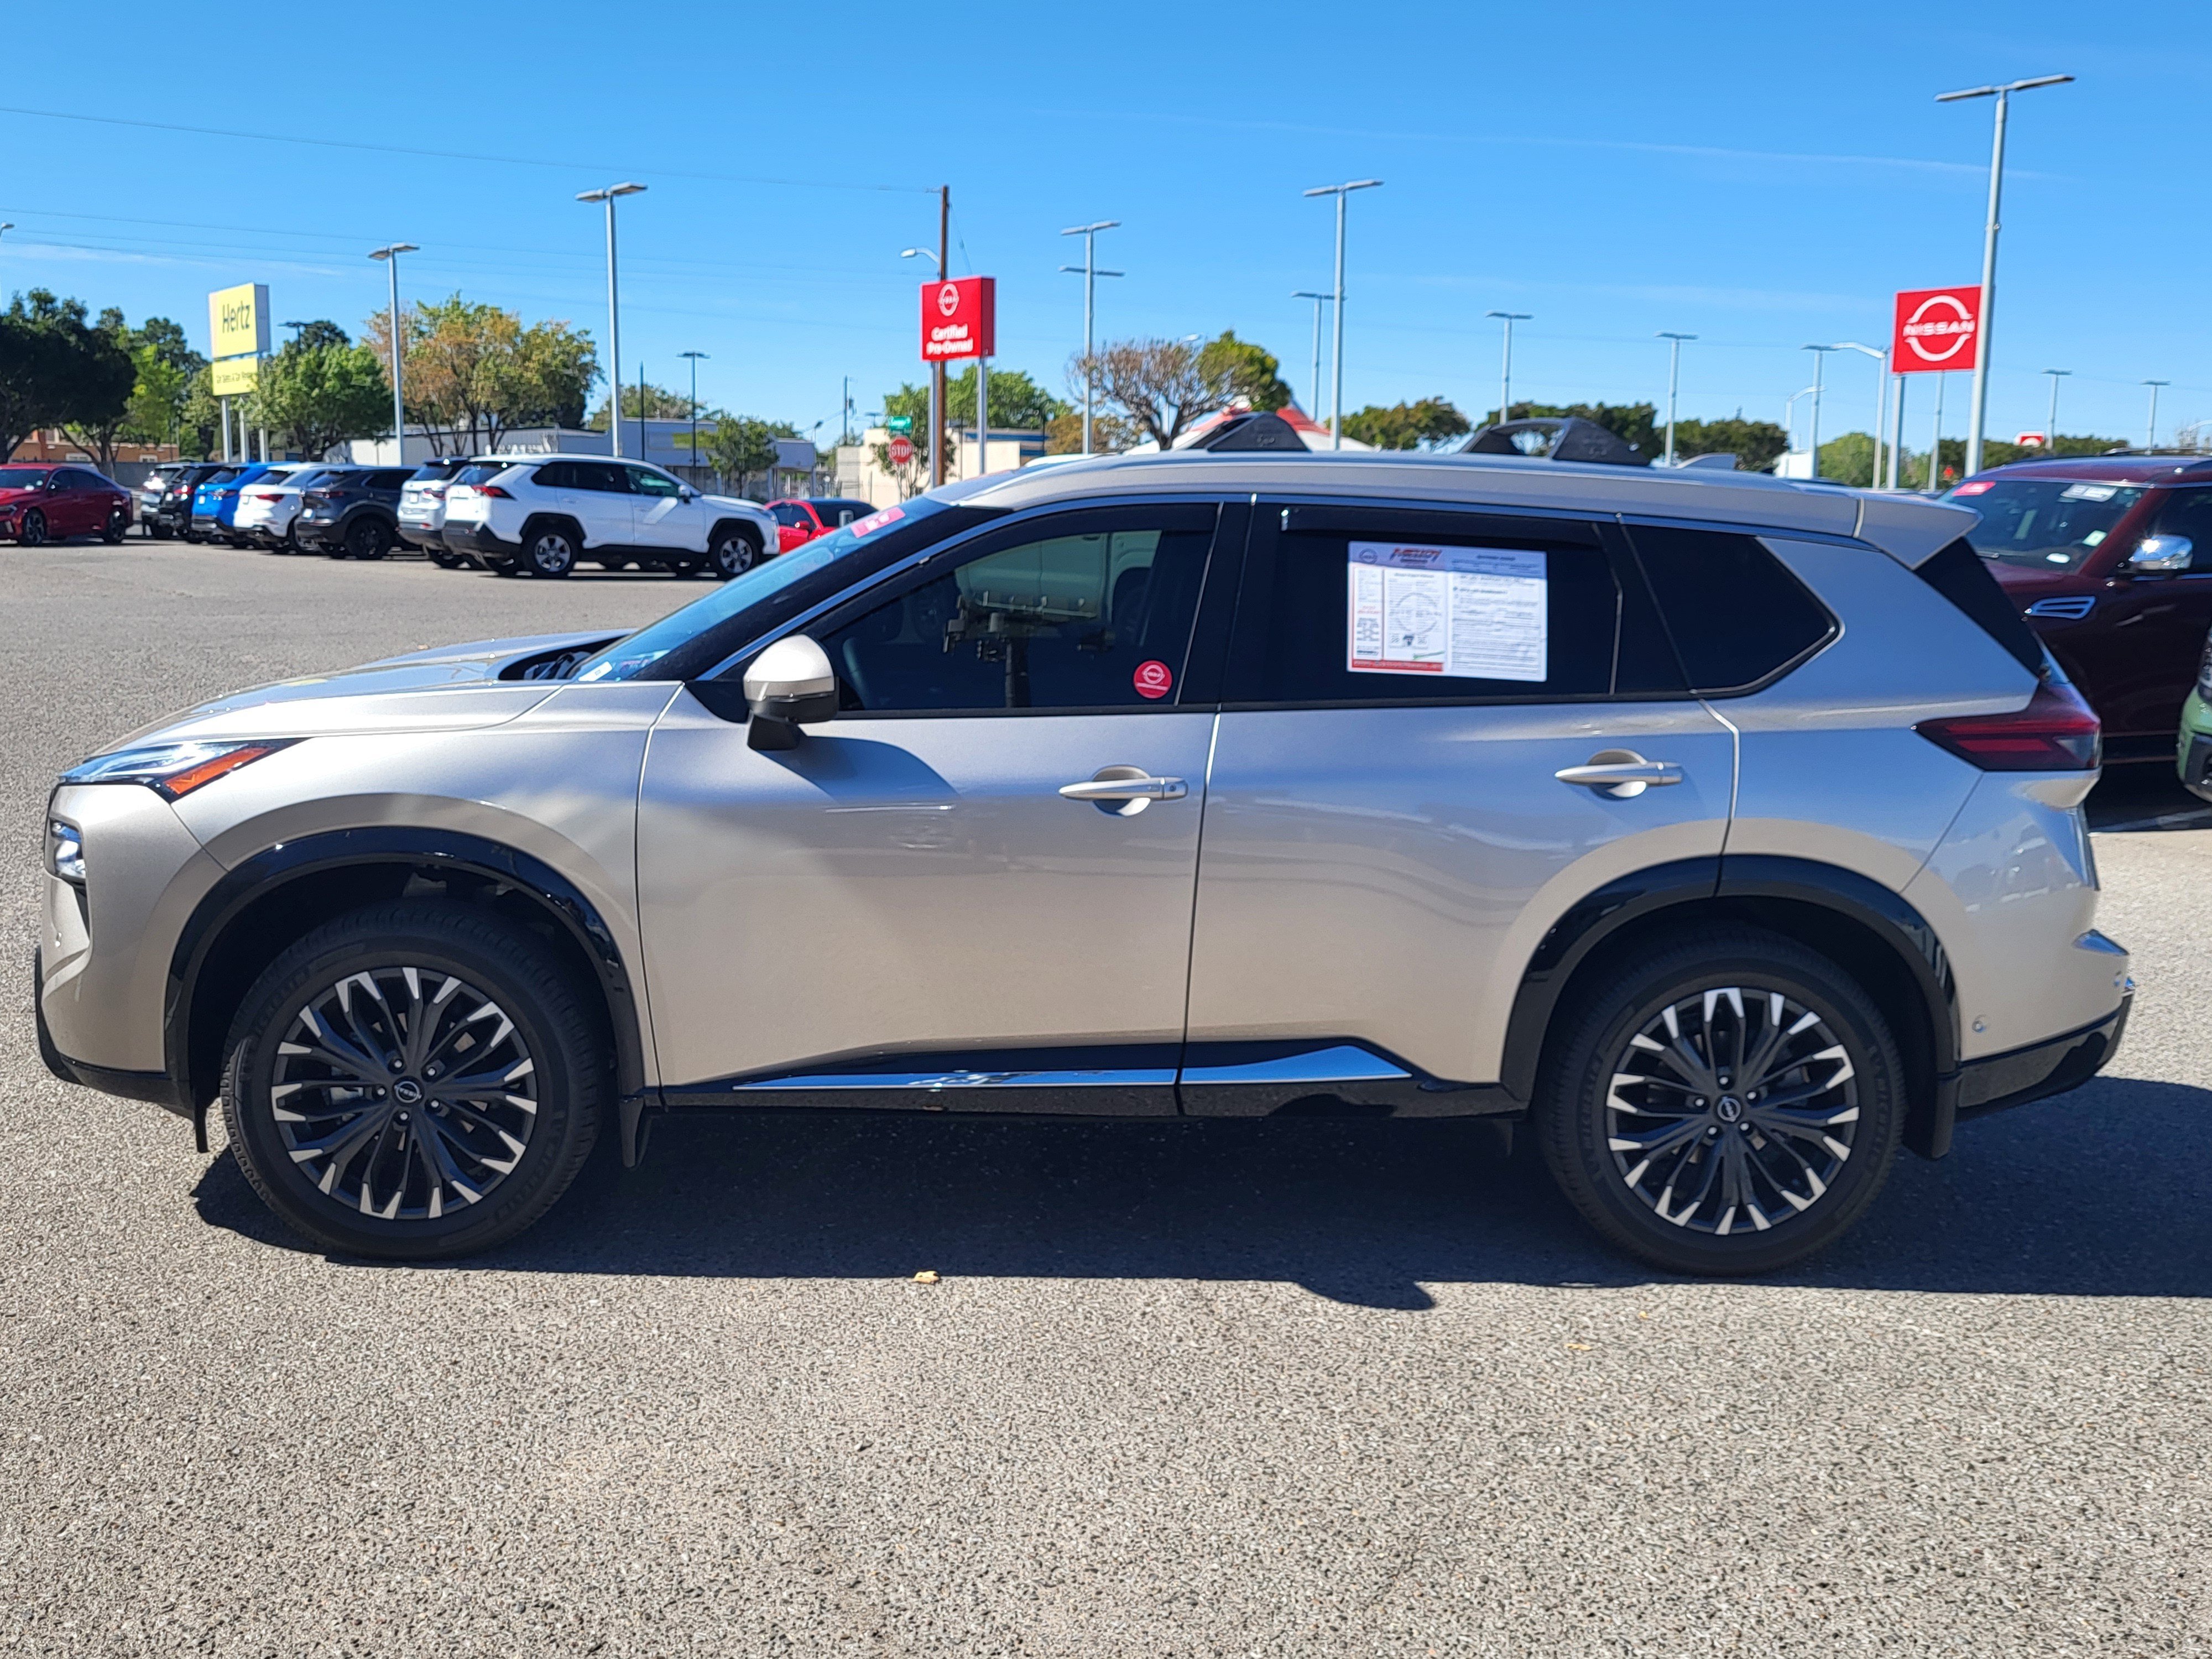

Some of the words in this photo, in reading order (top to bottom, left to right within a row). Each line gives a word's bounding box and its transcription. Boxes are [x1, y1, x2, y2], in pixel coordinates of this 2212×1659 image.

[222, 300, 251, 333] Hertz
[931, 323, 968, 341] Certified
[1903, 320, 1975, 337] NISSAN
[926, 336, 973, 356] Pre-Owned
[891, 444, 912, 458] STOP
